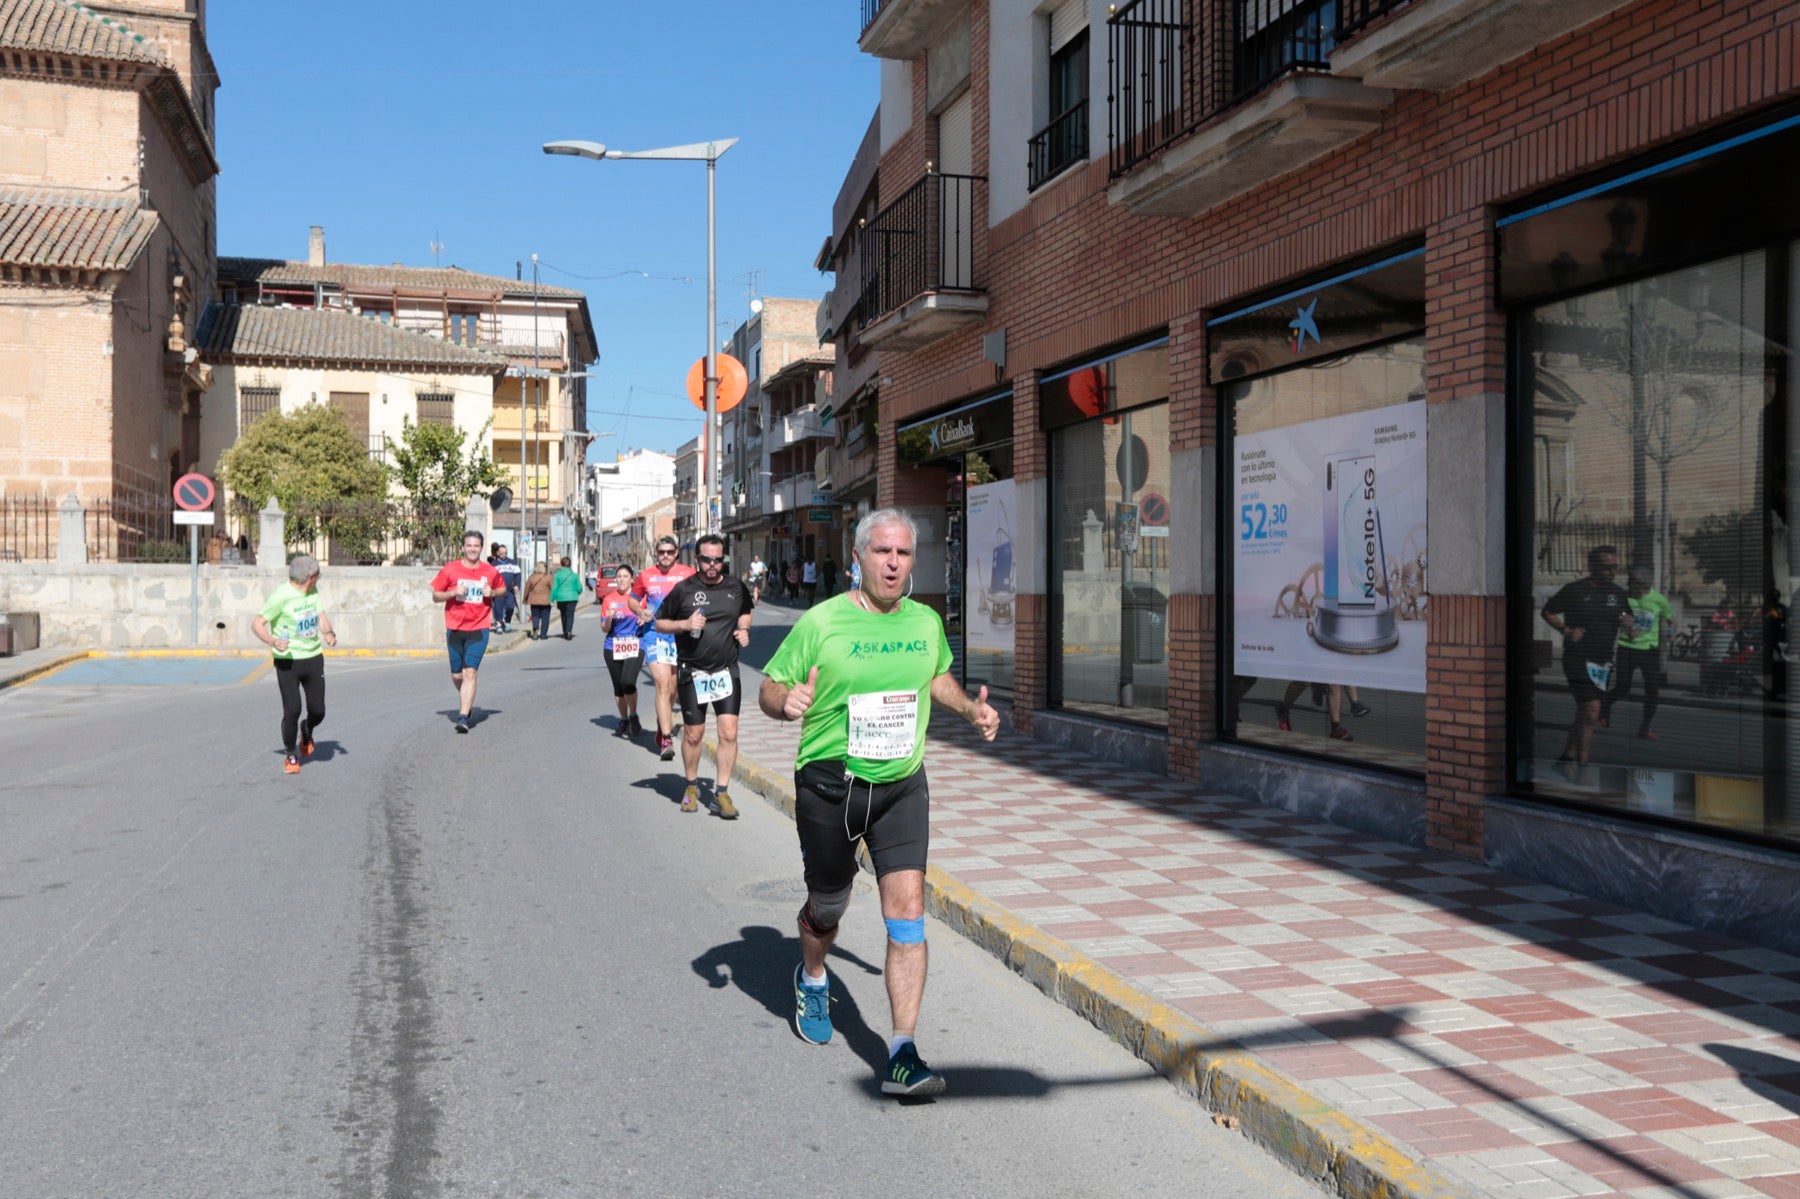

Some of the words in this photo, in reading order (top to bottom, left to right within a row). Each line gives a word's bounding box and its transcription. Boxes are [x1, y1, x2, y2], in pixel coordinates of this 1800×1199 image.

[941, 416, 974, 443] CaixaBank
[1374, 424, 1397, 435] SAMSUNG
[1241, 464, 1250, 473] con
[1364, 468, 1375, 500] 5G
[1364, 508, 1375, 599] Note10+
[615, 643, 638, 653] 2002
[701, 678, 726, 692] 704
[879, 721, 905, 729] CANCER
